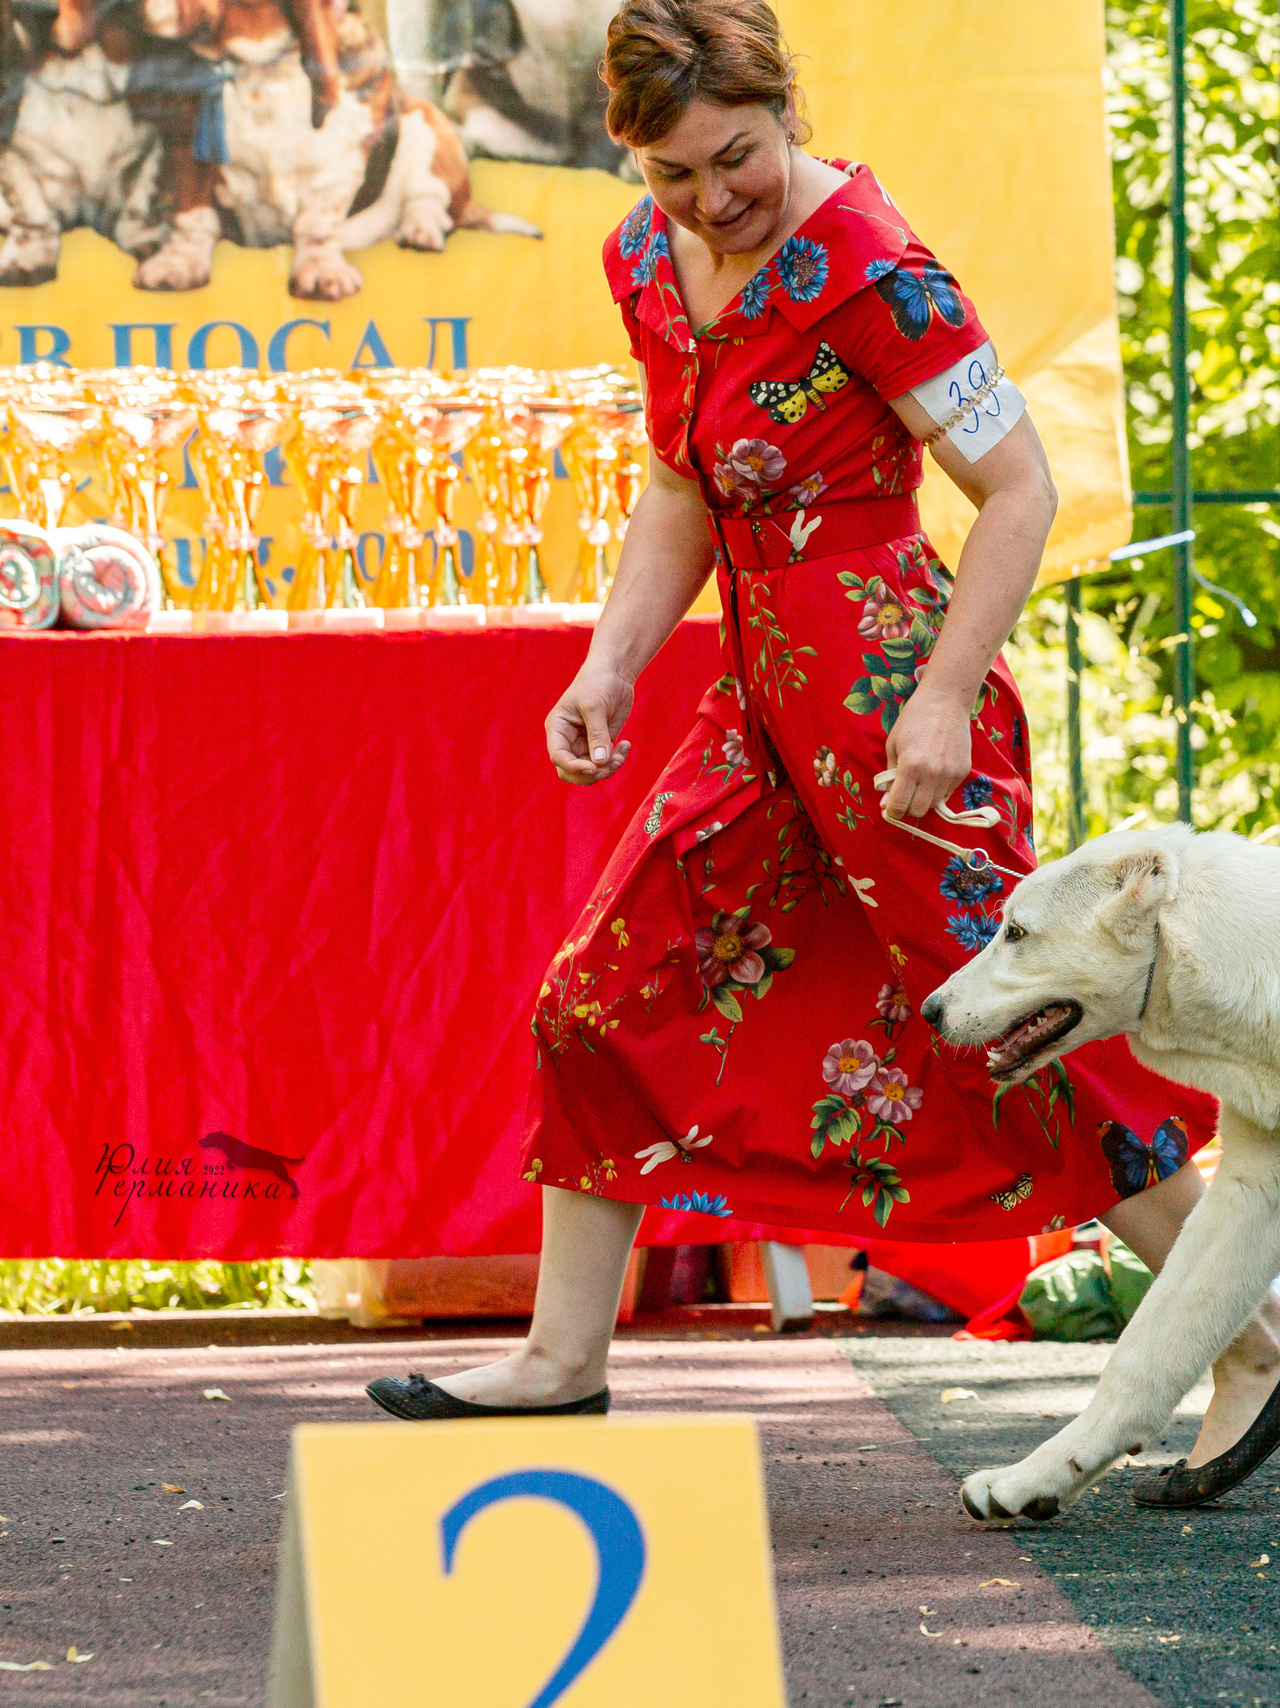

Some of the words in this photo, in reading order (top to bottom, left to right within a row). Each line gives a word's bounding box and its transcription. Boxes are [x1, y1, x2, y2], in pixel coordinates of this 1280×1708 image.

[0, 325, 72, 370] В
[949, 360, 1001, 434] 39
[439, 1466, 647, 1708] 2
